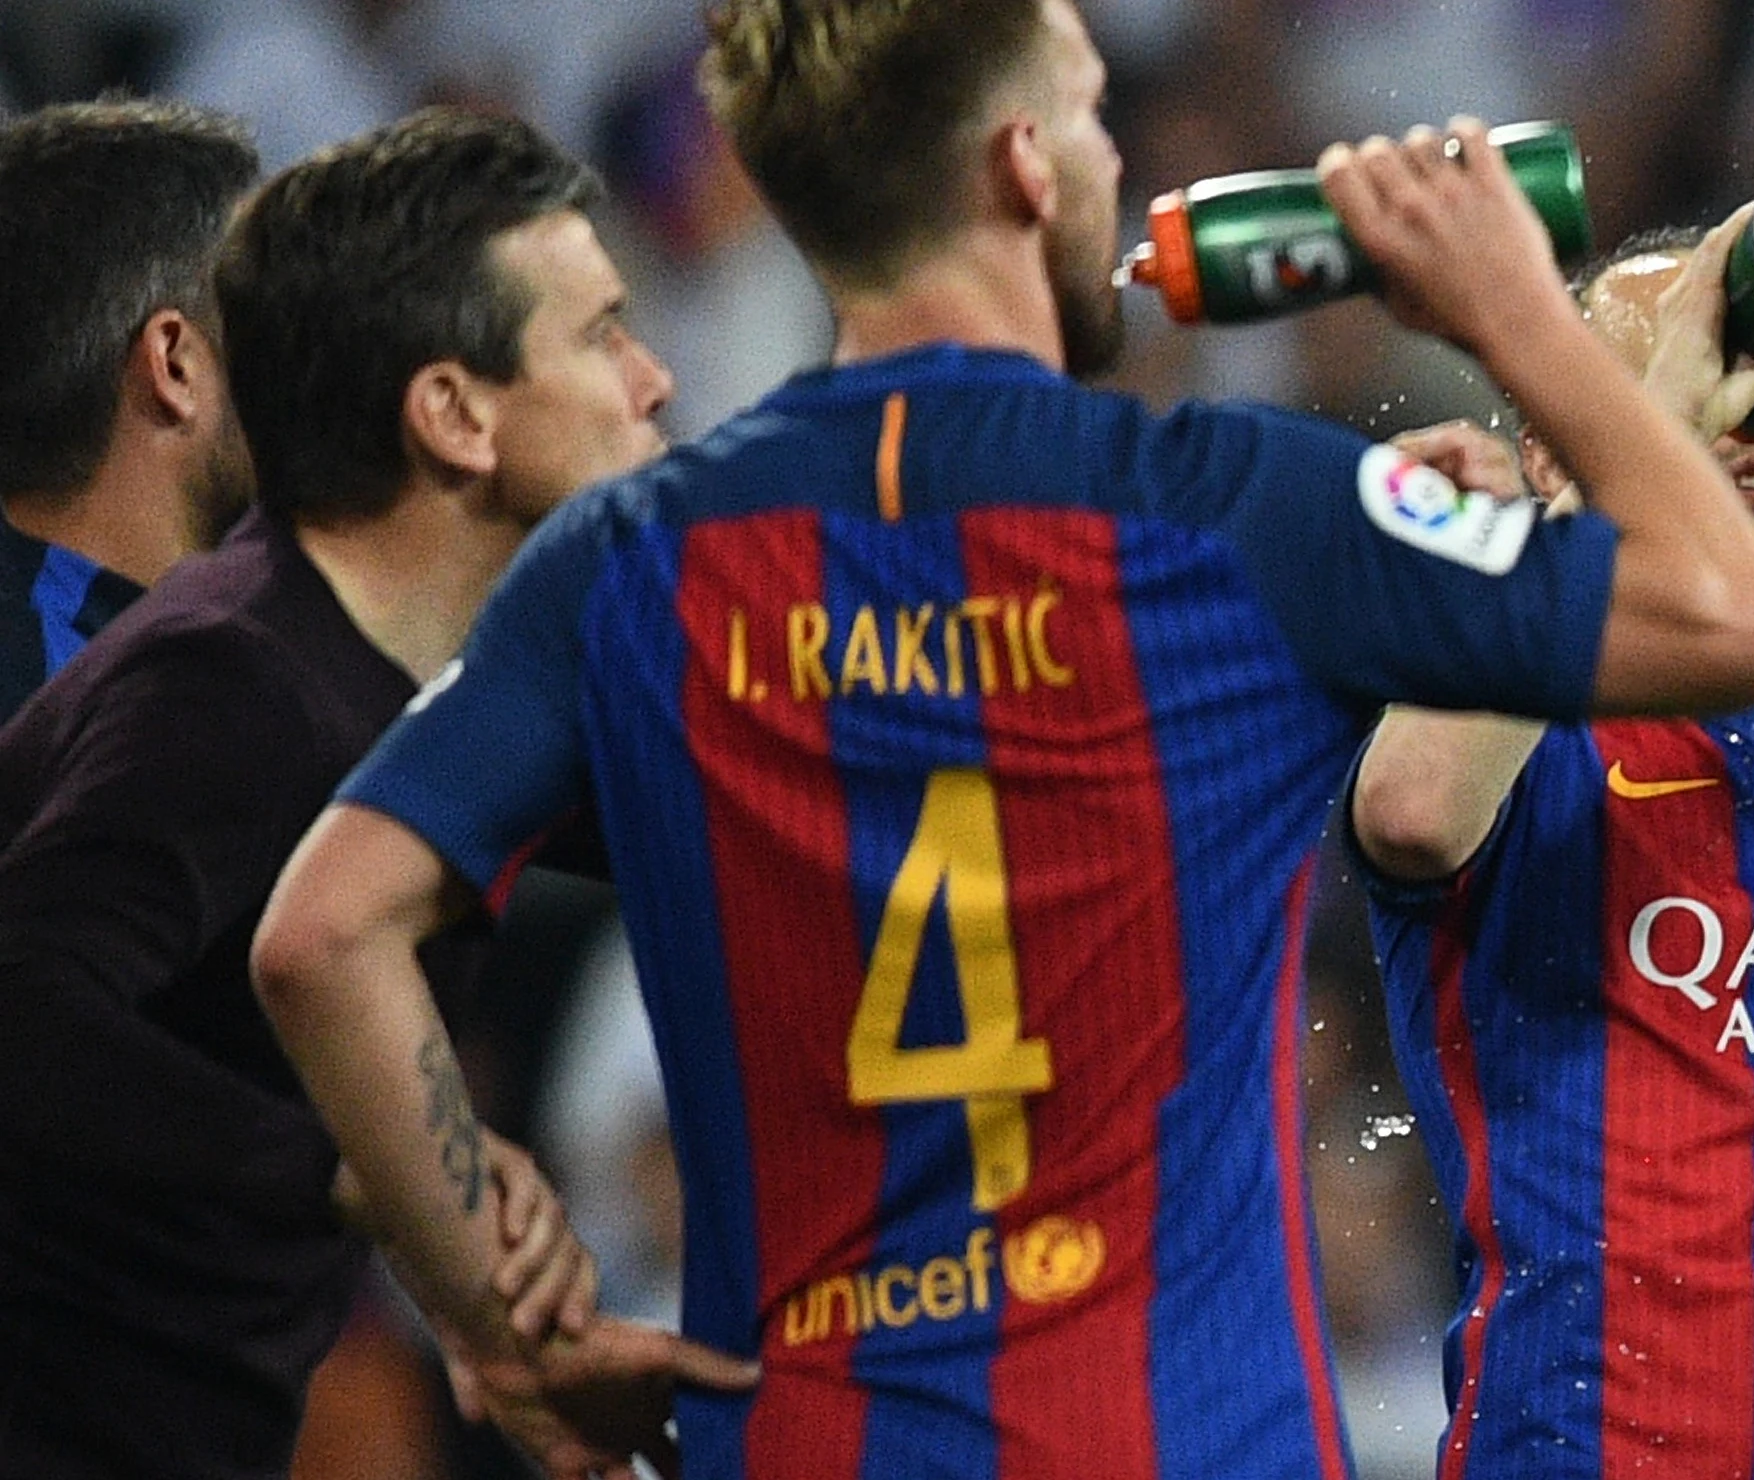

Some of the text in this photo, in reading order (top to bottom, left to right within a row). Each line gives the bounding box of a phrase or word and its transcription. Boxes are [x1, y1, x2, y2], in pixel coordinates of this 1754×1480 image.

[727, 606, 769, 704] I.
[846, 767, 1054, 1212] 4
[784, 1228, 997, 1346] unicef
